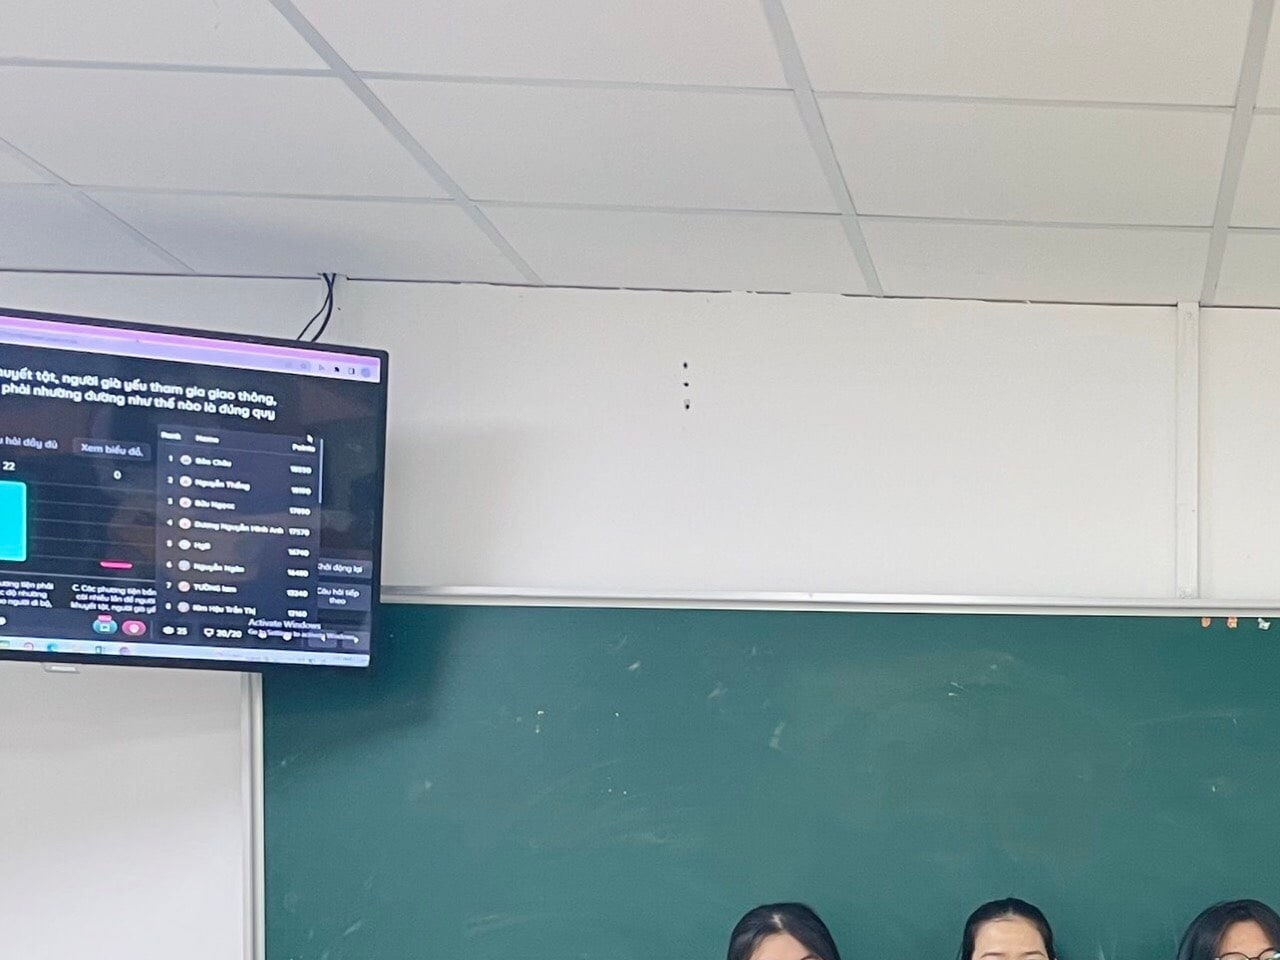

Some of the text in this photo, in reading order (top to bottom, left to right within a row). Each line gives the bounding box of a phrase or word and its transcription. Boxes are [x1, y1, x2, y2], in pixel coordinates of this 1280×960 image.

[62, 374, 98, 387] người
[101, 377, 122, 390] già
[124, 378, 148, 392] yếu
[150, 382, 183, 395] tham
[185, 386, 206, 398] gia
[208, 388, 236, 401] giao
[1, 383, 31, 396] phải
[154, 397, 176, 410] thế
[177, 400, 202, 412] nào
[204, 402, 216, 413] là
[218, 404, 250, 419] đúng
[252, 408, 276, 421] quy
[81, 443, 104, 454] Xem
[2, 461, 16, 471] 22
[248, 618, 322, 630] Activate Windows
